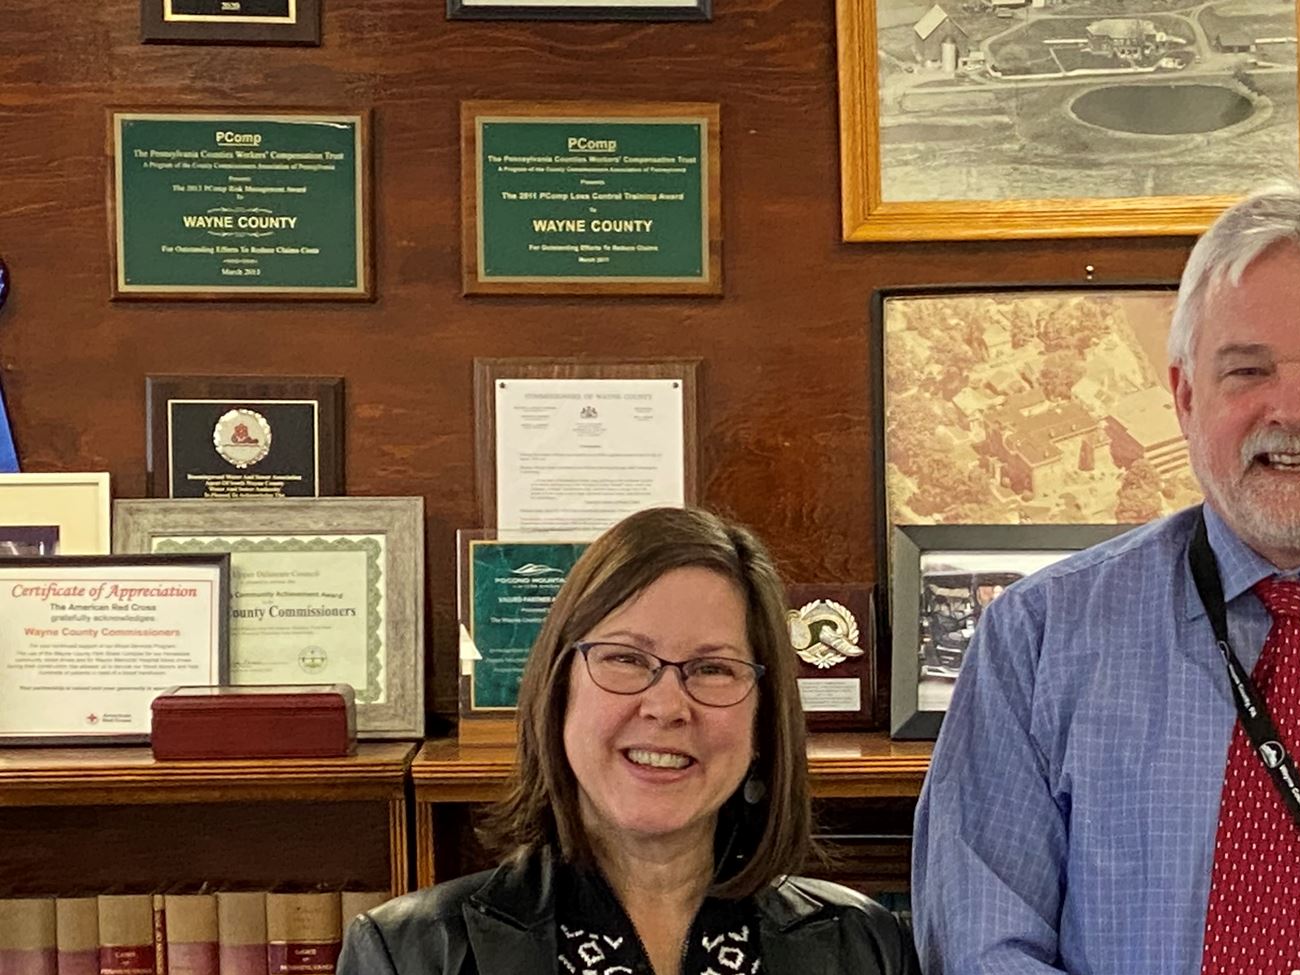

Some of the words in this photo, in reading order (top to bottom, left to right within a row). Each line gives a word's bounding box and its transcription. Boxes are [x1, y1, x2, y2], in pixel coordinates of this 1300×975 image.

[216, 131, 262, 146] PComp
[567, 137, 617, 151] PComp
[134, 149, 148, 158] The
[150, 149, 199, 160] Pennsylvania
[487, 155, 502, 163] The
[503, 155, 553, 164] Pennsylvania
[678, 156, 697, 164] Trust
[501, 191, 518, 200] The
[539, 192, 569, 201] PComp
[591, 192, 622, 200] Control
[623, 192, 658, 201] Training
[658, 193, 684, 201] Award
[183, 216, 233, 229] WAYNE
[237, 216, 297, 229] COUNTY
[532, 219, 586, 232] WAYNE
[590, 219, 653, 232] COUNTY
[11, 582, 86, 601] Certificate
[88, 583, 107, 601] of
[108, 583, 198, 602] Appreciation
[50, 603, 66, 611] The
[68, 603, 110, 612] American
[111, 603, 129, 611] Red
[131, 603, 157, 611] Cross
[232, 608, 266, 622] ounty
[269, 604, 357, 618] Commissioners
[50, 614, 91, 624] gratefully
[24, 628, 59, 638] Wayne
[62, 628, 100, 638] County
[101, 628, 181, 637] Commissioners
